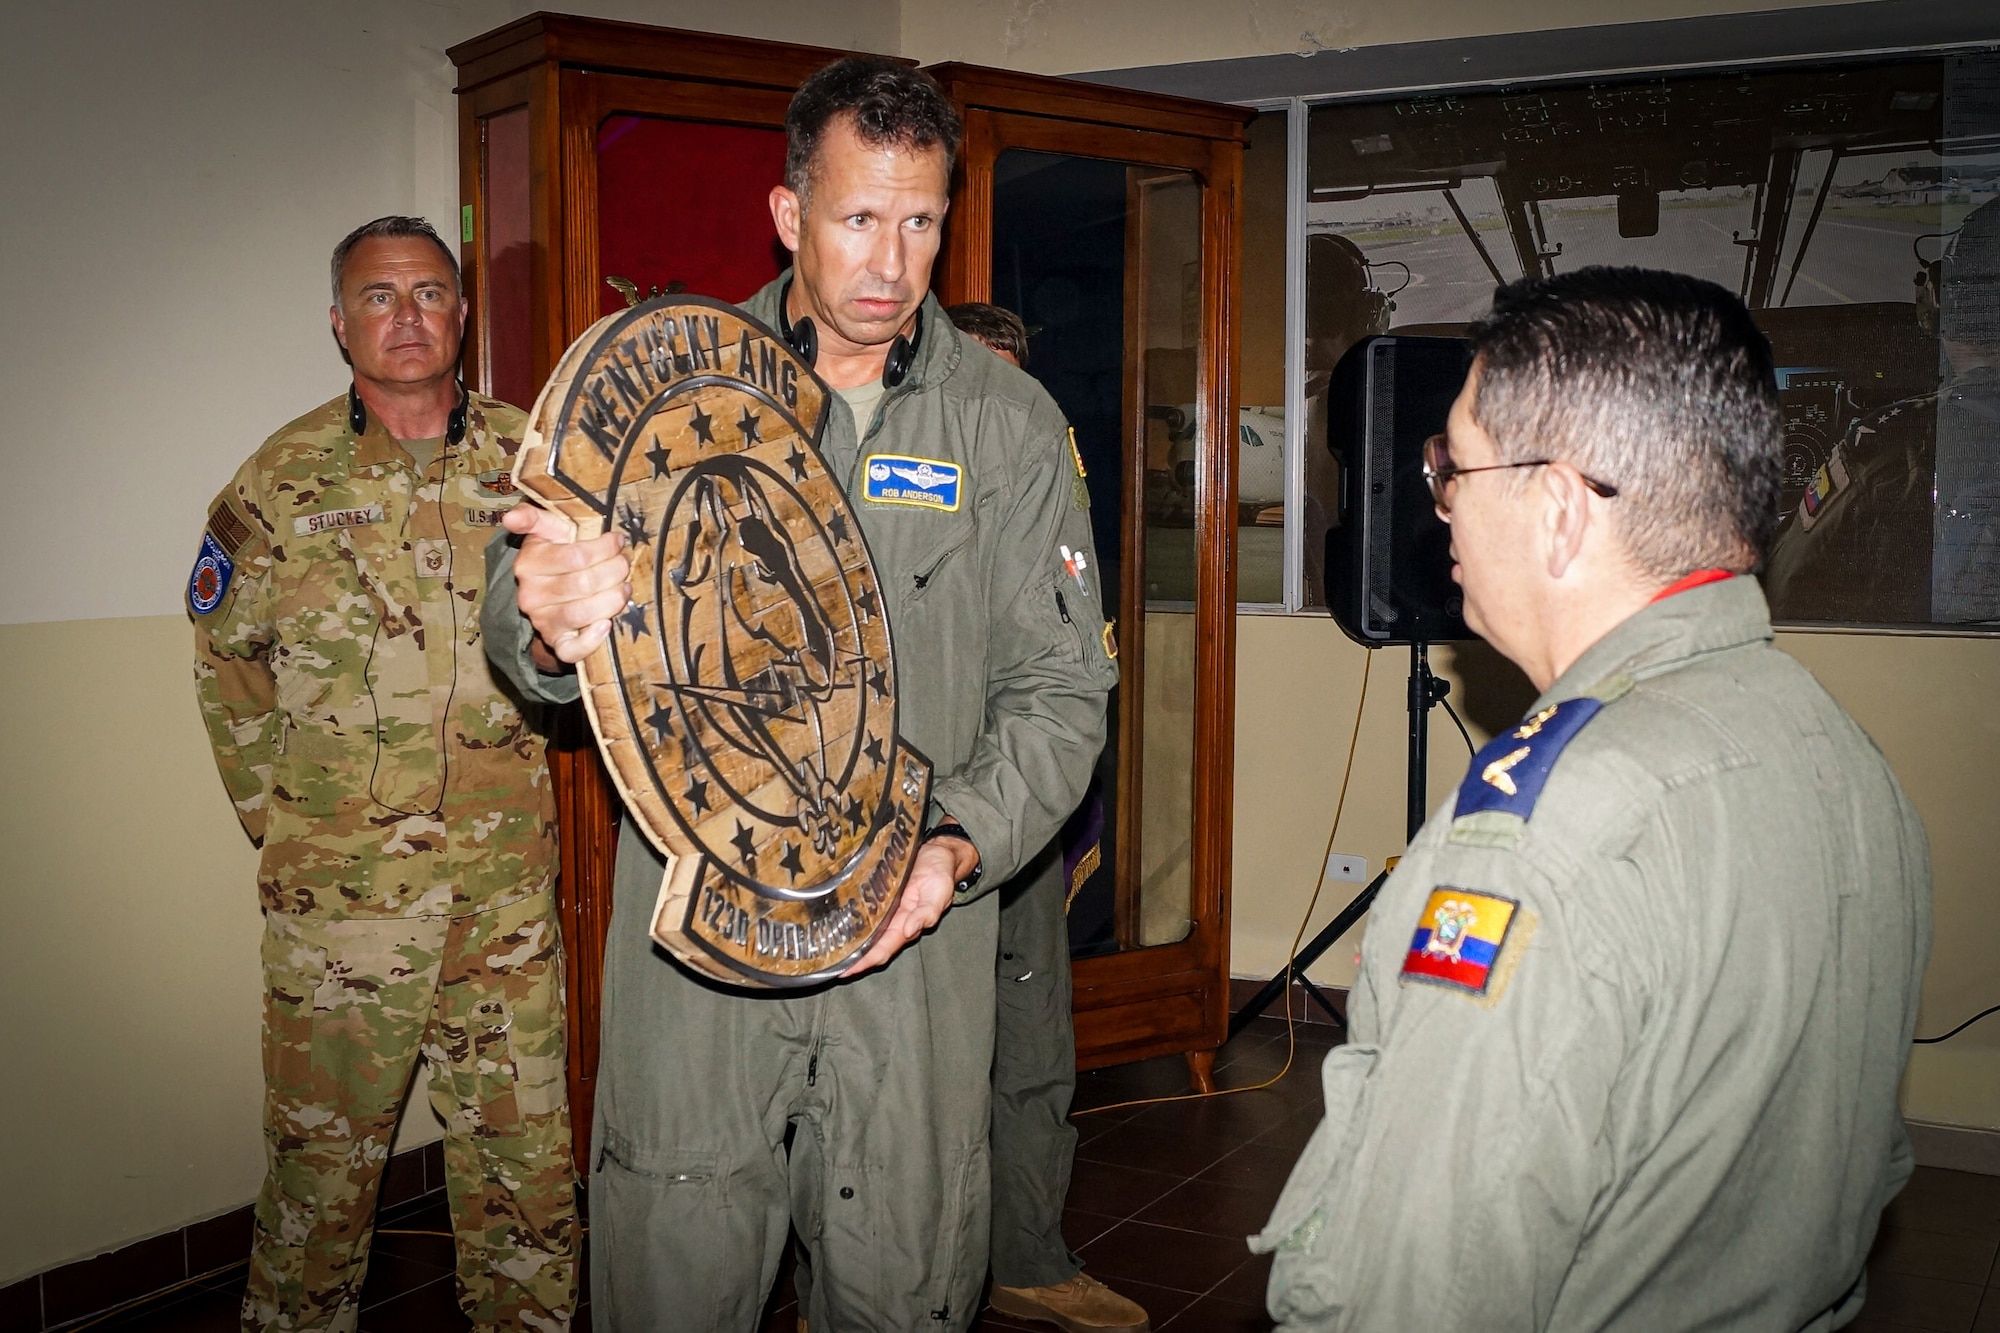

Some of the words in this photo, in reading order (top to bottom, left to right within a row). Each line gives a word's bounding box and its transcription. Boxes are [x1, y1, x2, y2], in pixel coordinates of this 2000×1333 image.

[578, 313, 722, 464] KENTUCKY
[739, 328, 799, 409] ANG
[309, 509, 371, 531] STUCKEY
[881, 488, 900, 498] ROB
[901, 489, 944, 504] ANDERSON
[702, 886, 749, 946] 123D
[861, 801, 917, 916] SUPPORT
